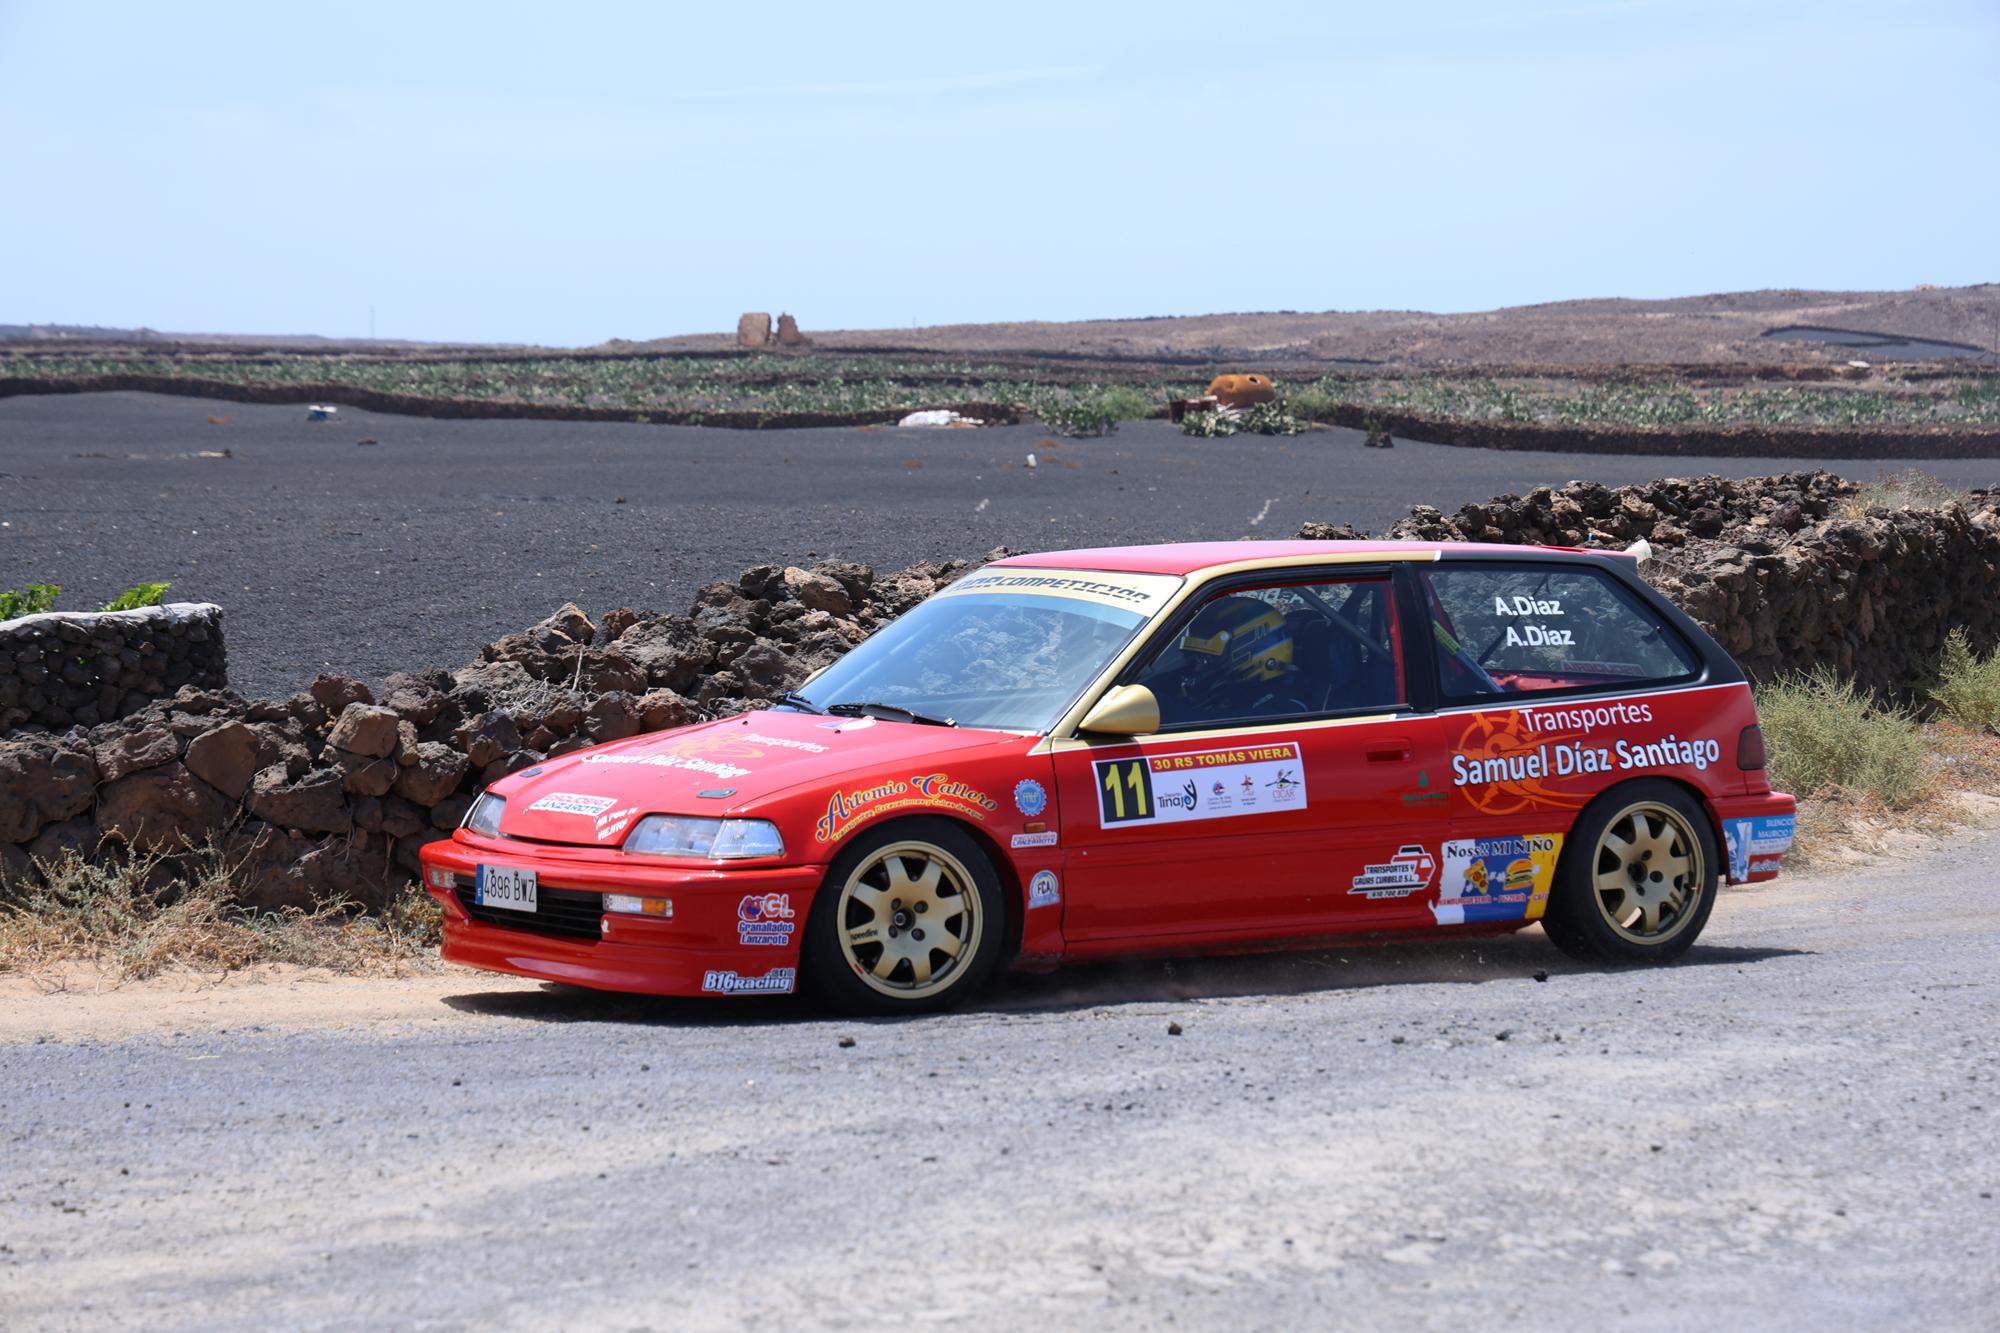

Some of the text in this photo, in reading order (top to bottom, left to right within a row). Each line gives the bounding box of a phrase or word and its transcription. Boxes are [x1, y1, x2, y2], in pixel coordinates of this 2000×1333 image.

[1495, 596, 1564, 616] A.Diaz
[1518, 703, 1653, 733] Transportes
[1154, 748, 1292, 770] 30 RS TOMÁS VIERA
[1453, 734, 1720, 786] Samuel Díaz Santiago
[1105, 762, 1147, 818] 11
[816, 773, 998, 843] Artemio Callero
[1492, 842, 1510, 856] MI
[1514, 835, 1554, 855] NIÑO
[1366, 864, 1409, 875] TRANSPORTES
[484, 874, 535, 903] 4896 BWZ
[1037, 880, 1051, 895] FCA
[738, 921, 793, 933] Granallados
[741, 934, 788, 945] Lanzarote
